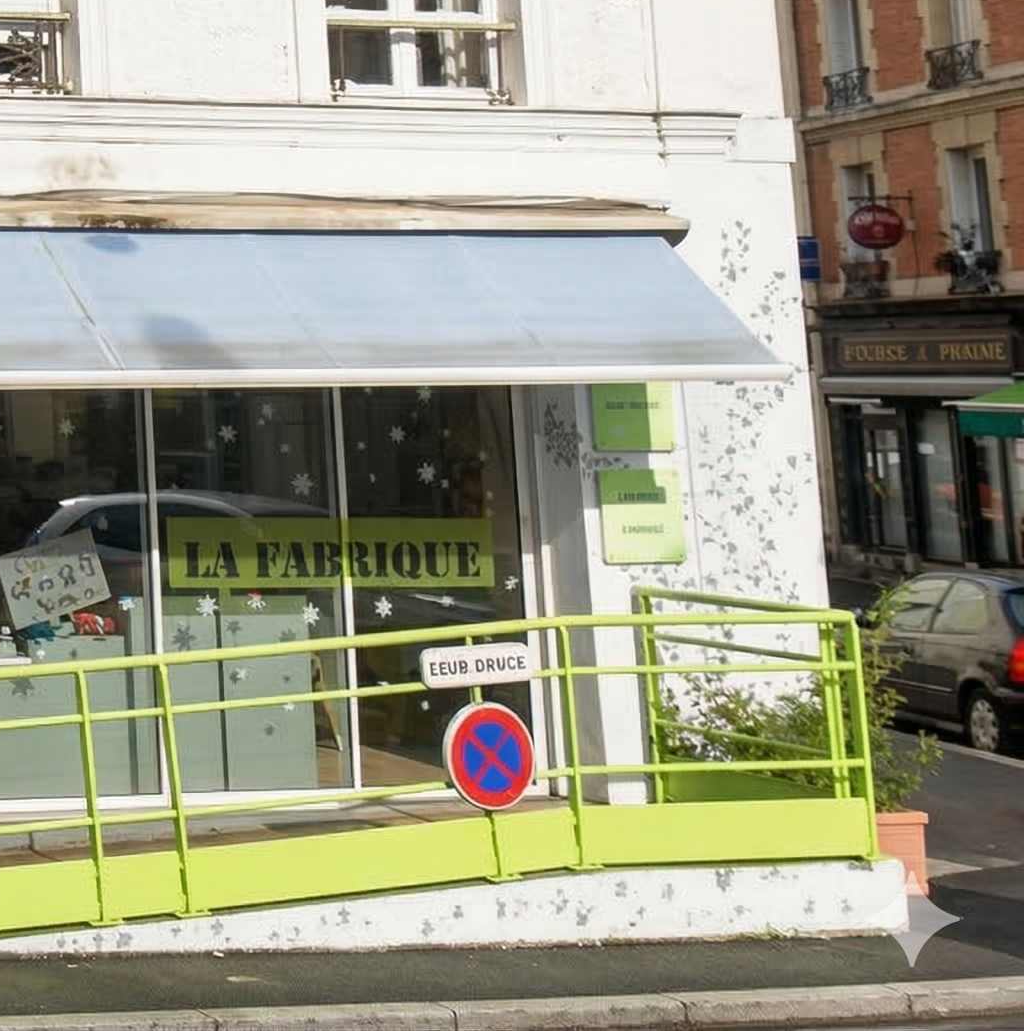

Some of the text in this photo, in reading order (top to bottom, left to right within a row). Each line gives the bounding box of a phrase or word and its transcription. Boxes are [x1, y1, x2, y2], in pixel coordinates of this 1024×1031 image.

[184, 541, 481, 578] LA FABRIQUE
[476, 655, 527, 673] DRUCE
